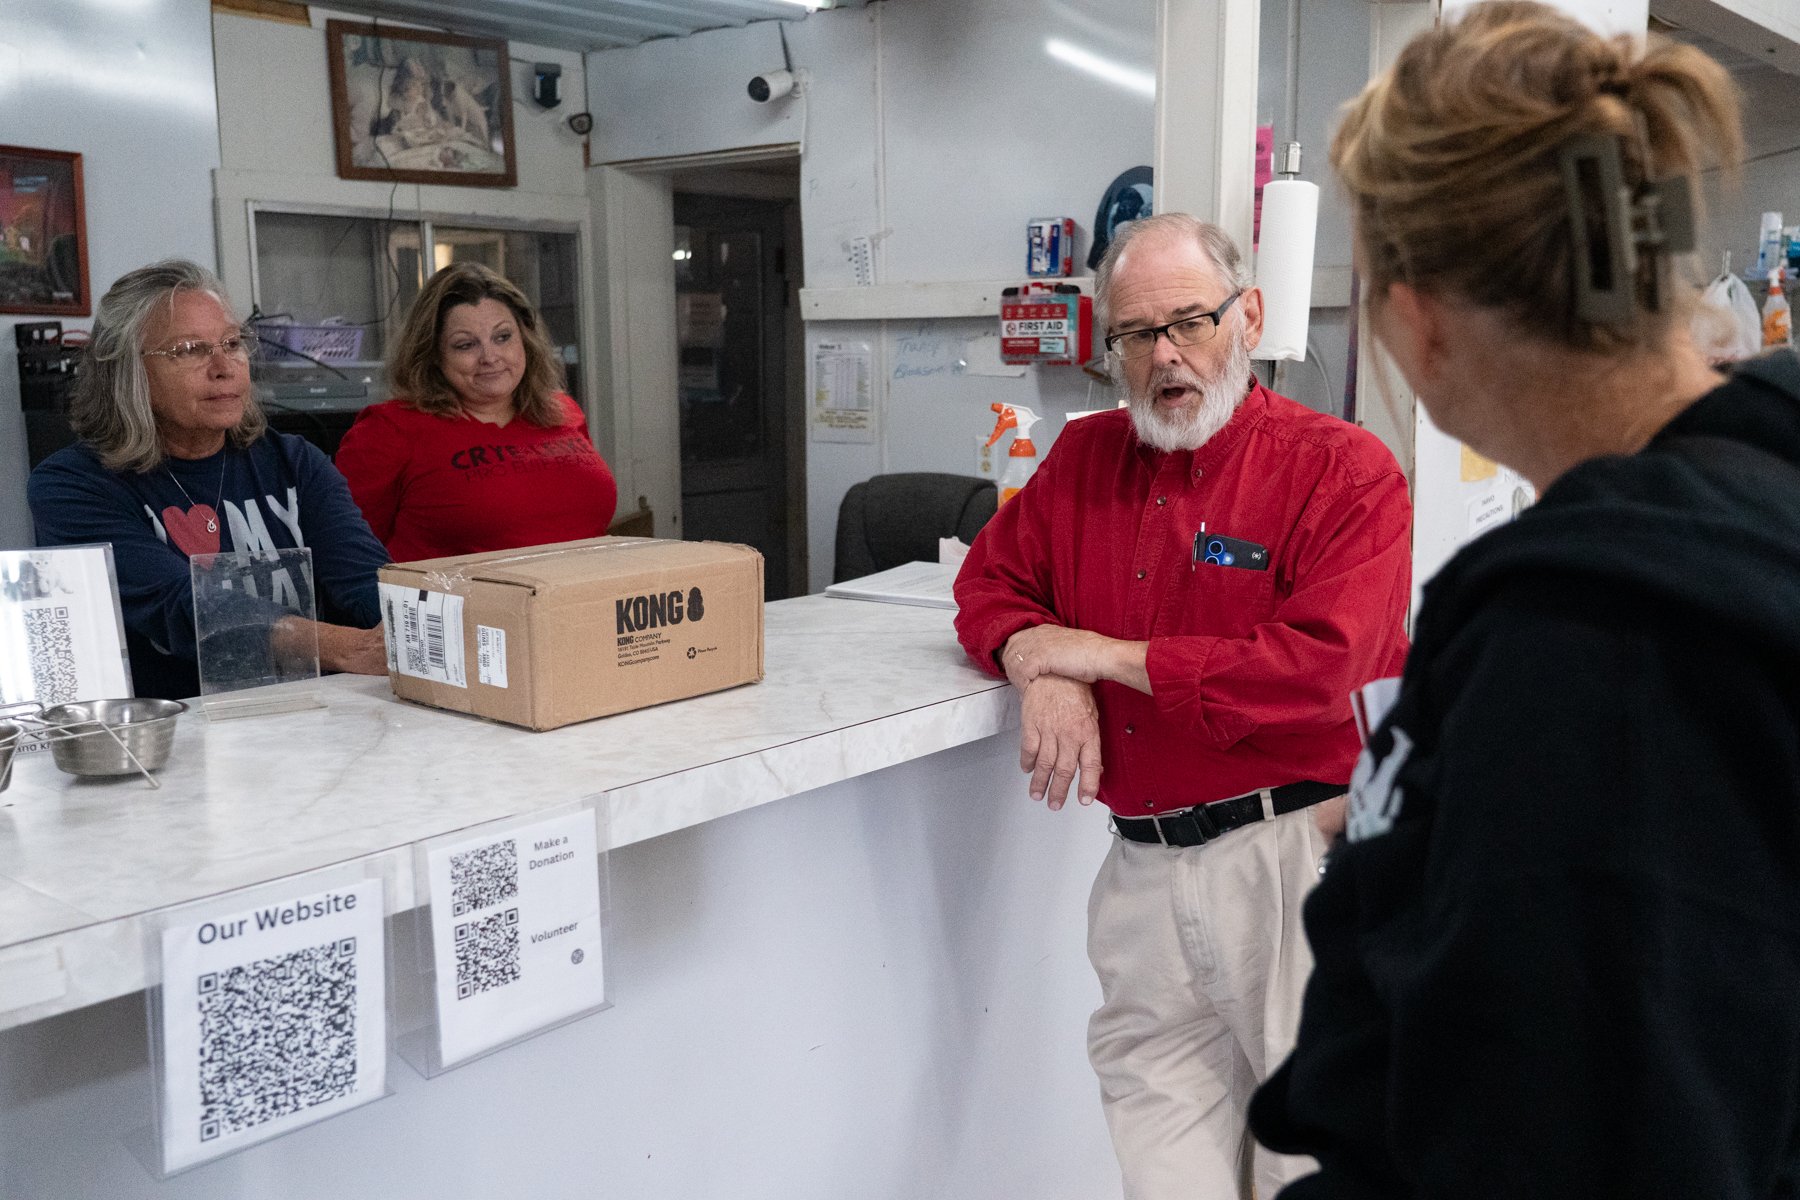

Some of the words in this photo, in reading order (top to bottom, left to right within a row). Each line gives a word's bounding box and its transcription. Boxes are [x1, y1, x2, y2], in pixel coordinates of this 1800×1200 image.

[1018, 321, 1044, 331] FIRST
[1046, 320, 1063, 330] AID
[222, 486, 305, 568] MY
[616, 590, 684, 635] KONG
[617, 636, 634, 647] KONG
[634, 633, 662, 643] COMPANY
[533, 839, 559, 852] Make
[562, 836, 569, 845] a
[528, 850, 575, 871] Donation
[197, 917, 249, 945] Our
[254, 893, 357, 931] Website
[530, 921, 579, 945] Volunteer
